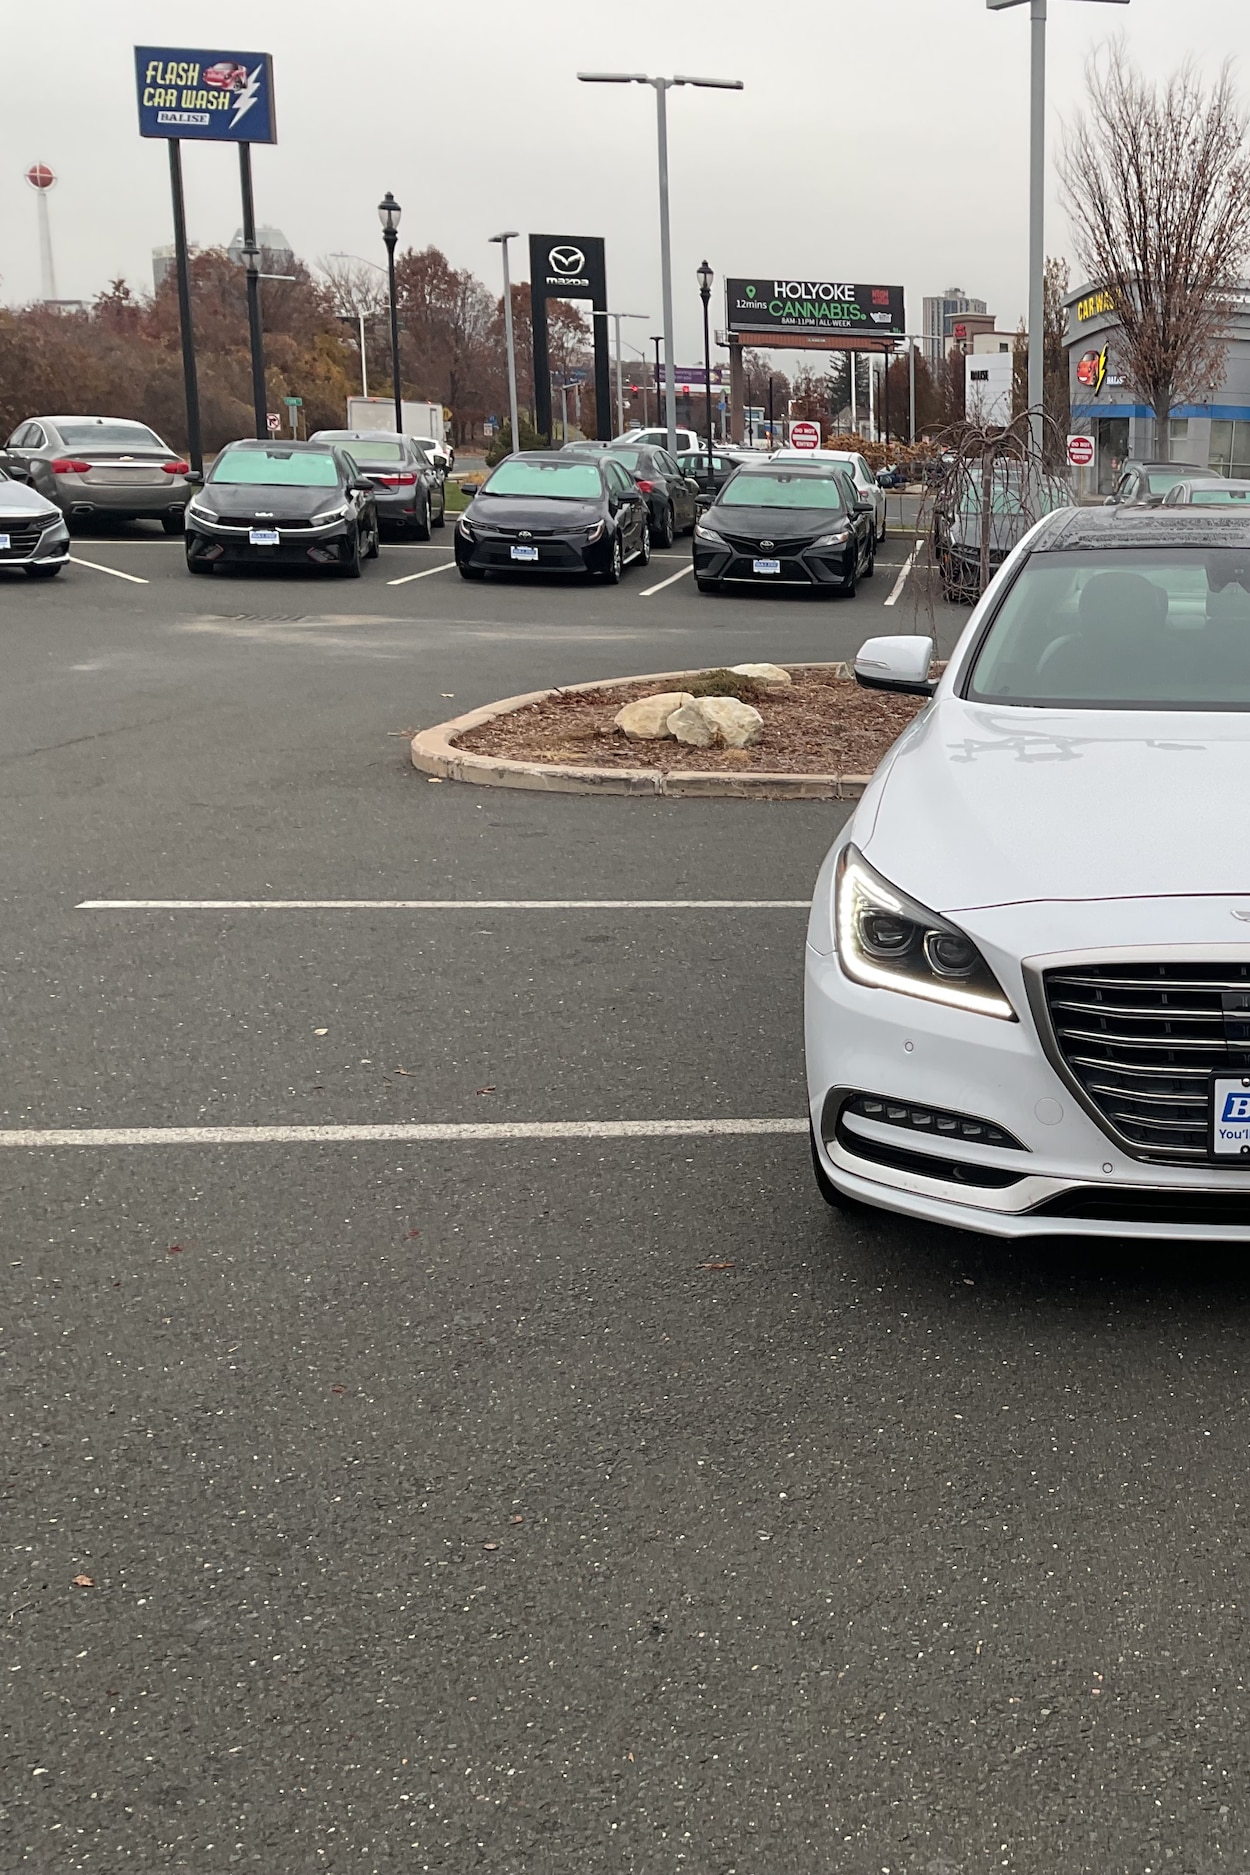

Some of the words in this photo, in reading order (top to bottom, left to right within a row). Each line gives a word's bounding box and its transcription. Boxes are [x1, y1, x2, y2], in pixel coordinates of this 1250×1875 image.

[145, 60, 200, 86] FLASH
[143, 87, 178, 108] CAR
[181, 89, 230, 110] WASH
[160, 112, 208, 123] BALISE
[773, 281, 855, 301] HOLYOKE
[736, 299, 768, 310] 12mins
[1077, 296, 1094, 322] CAR
[781, 317, 815, 326] 8AM-11PM
